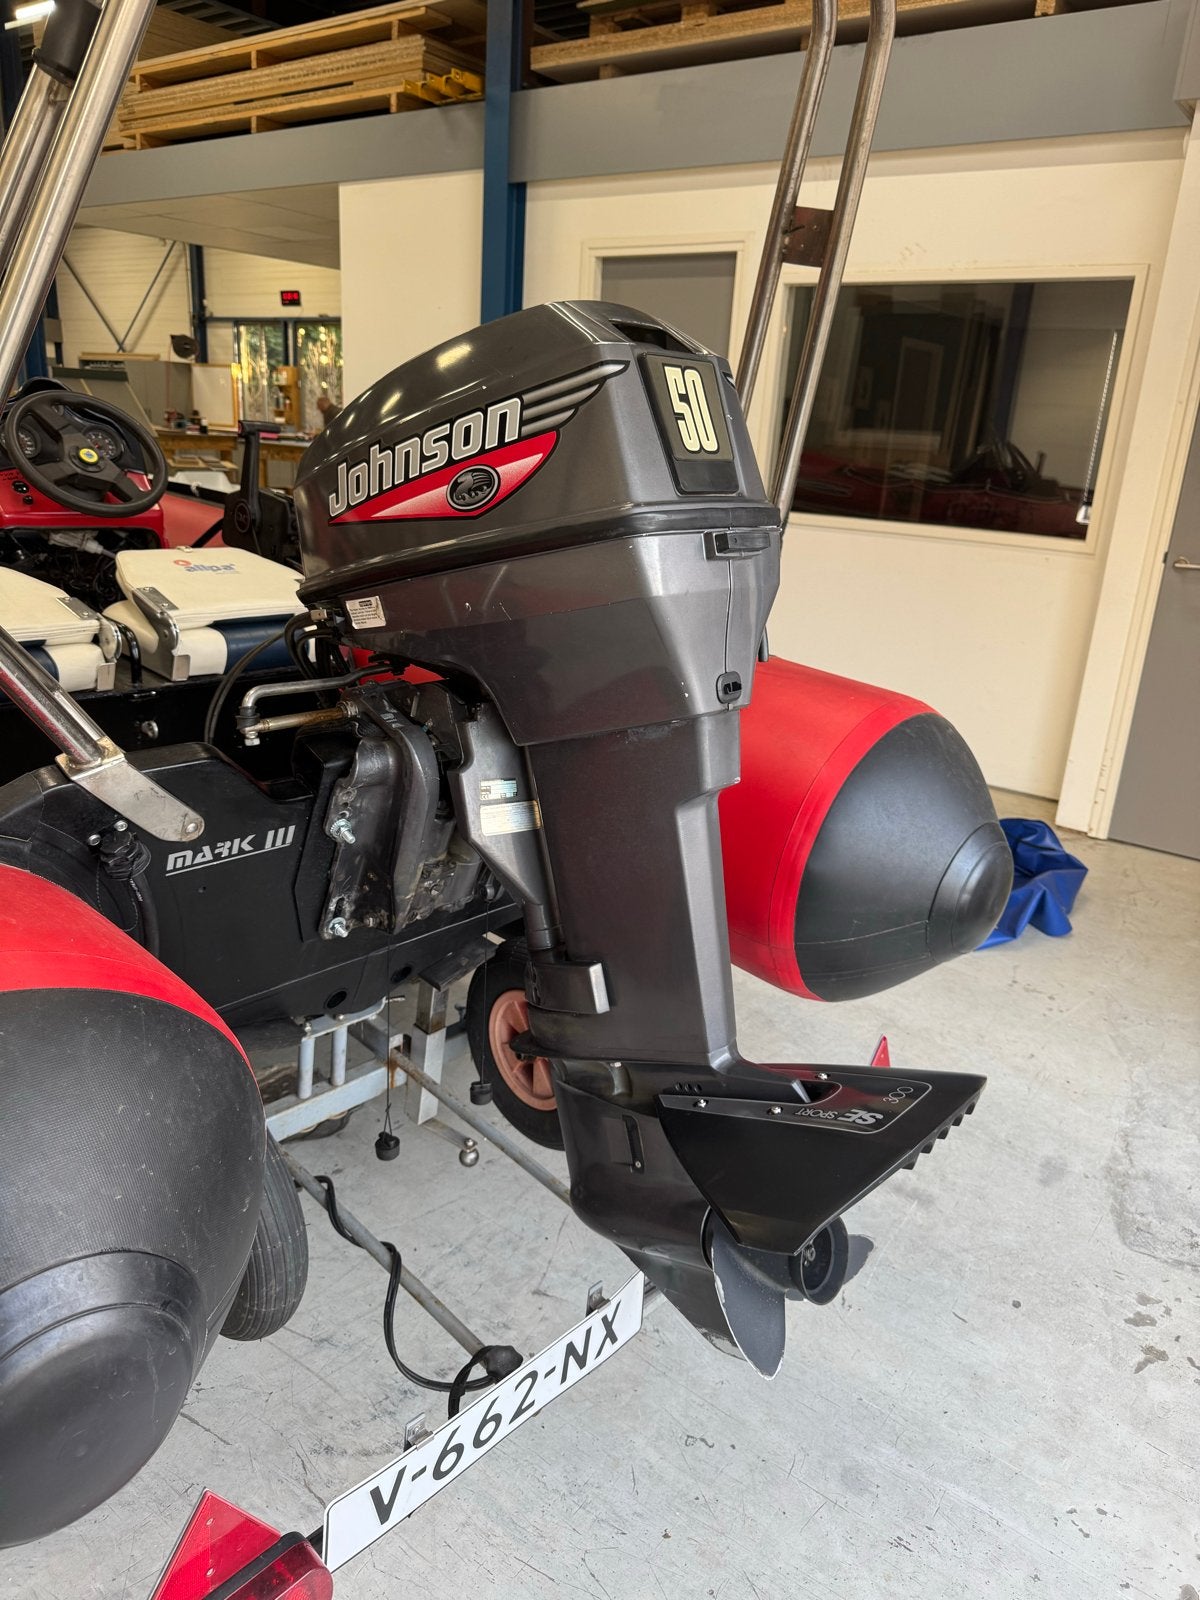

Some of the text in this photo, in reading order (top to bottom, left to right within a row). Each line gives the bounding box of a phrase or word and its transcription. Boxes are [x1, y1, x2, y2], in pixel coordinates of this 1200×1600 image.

[663, 365, 719, 452] 50
[328, 397, 522, 517] Johnson
[166, 824, 297, 872] MARK III
[794, 1107, 884, 1125] SE SPORT
[882, 1086, 914, 1104] 300
[369, 1299, 622, 1526] V-662-NX
